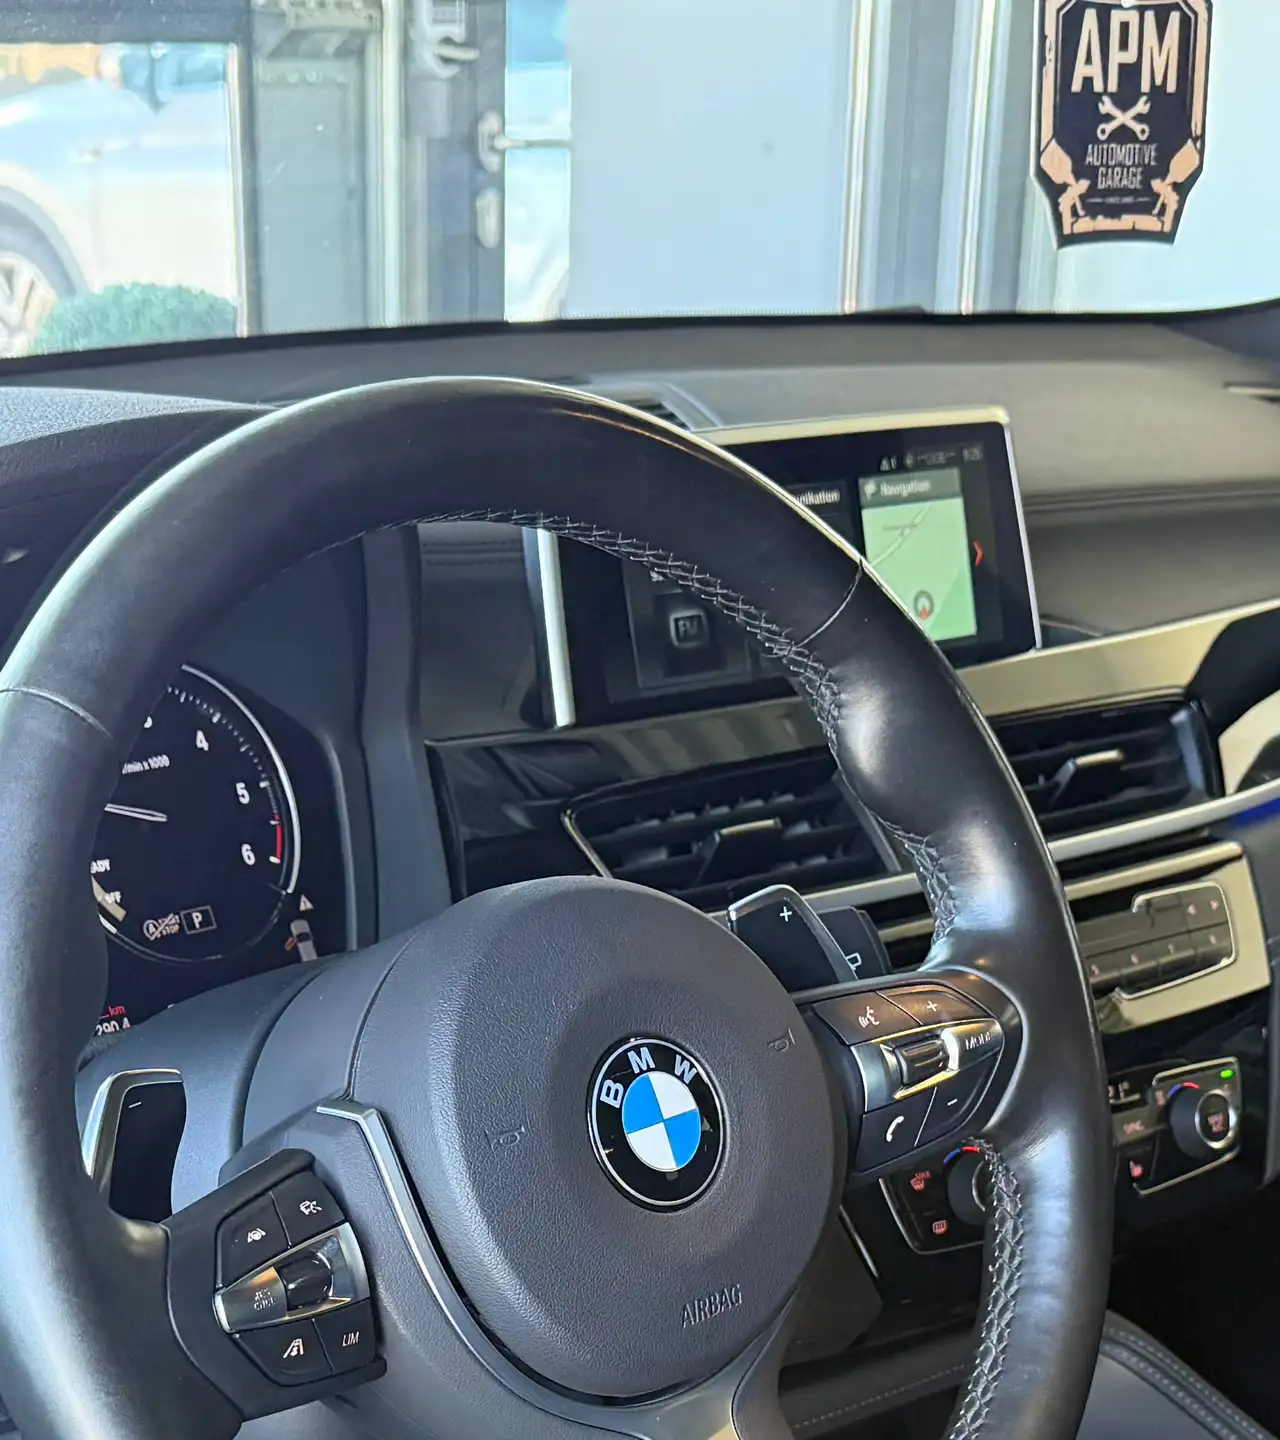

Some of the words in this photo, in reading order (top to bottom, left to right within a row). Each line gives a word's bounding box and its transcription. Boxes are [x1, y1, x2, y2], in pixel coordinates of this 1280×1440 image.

[1071, 8, 1181, 93] APM
[1085, 143, 1158, 166] AUTOMOTIVE
[1097, 166, 1143, 189] GARAGE
[880, 480, 931, 498] Navigation
[196, 730, 209, 751] 4
[235, 782, 251, 805] 5
[241, 844, 256, 866] 6
[90, 859, 110, 874] ADY
[191, 912, 203, 929] P
[599, 1045, 698, 1110] BMW
[681, 1283, 743, 1329] AIRBAG
[342, 1331, 360, 1347] LIM
